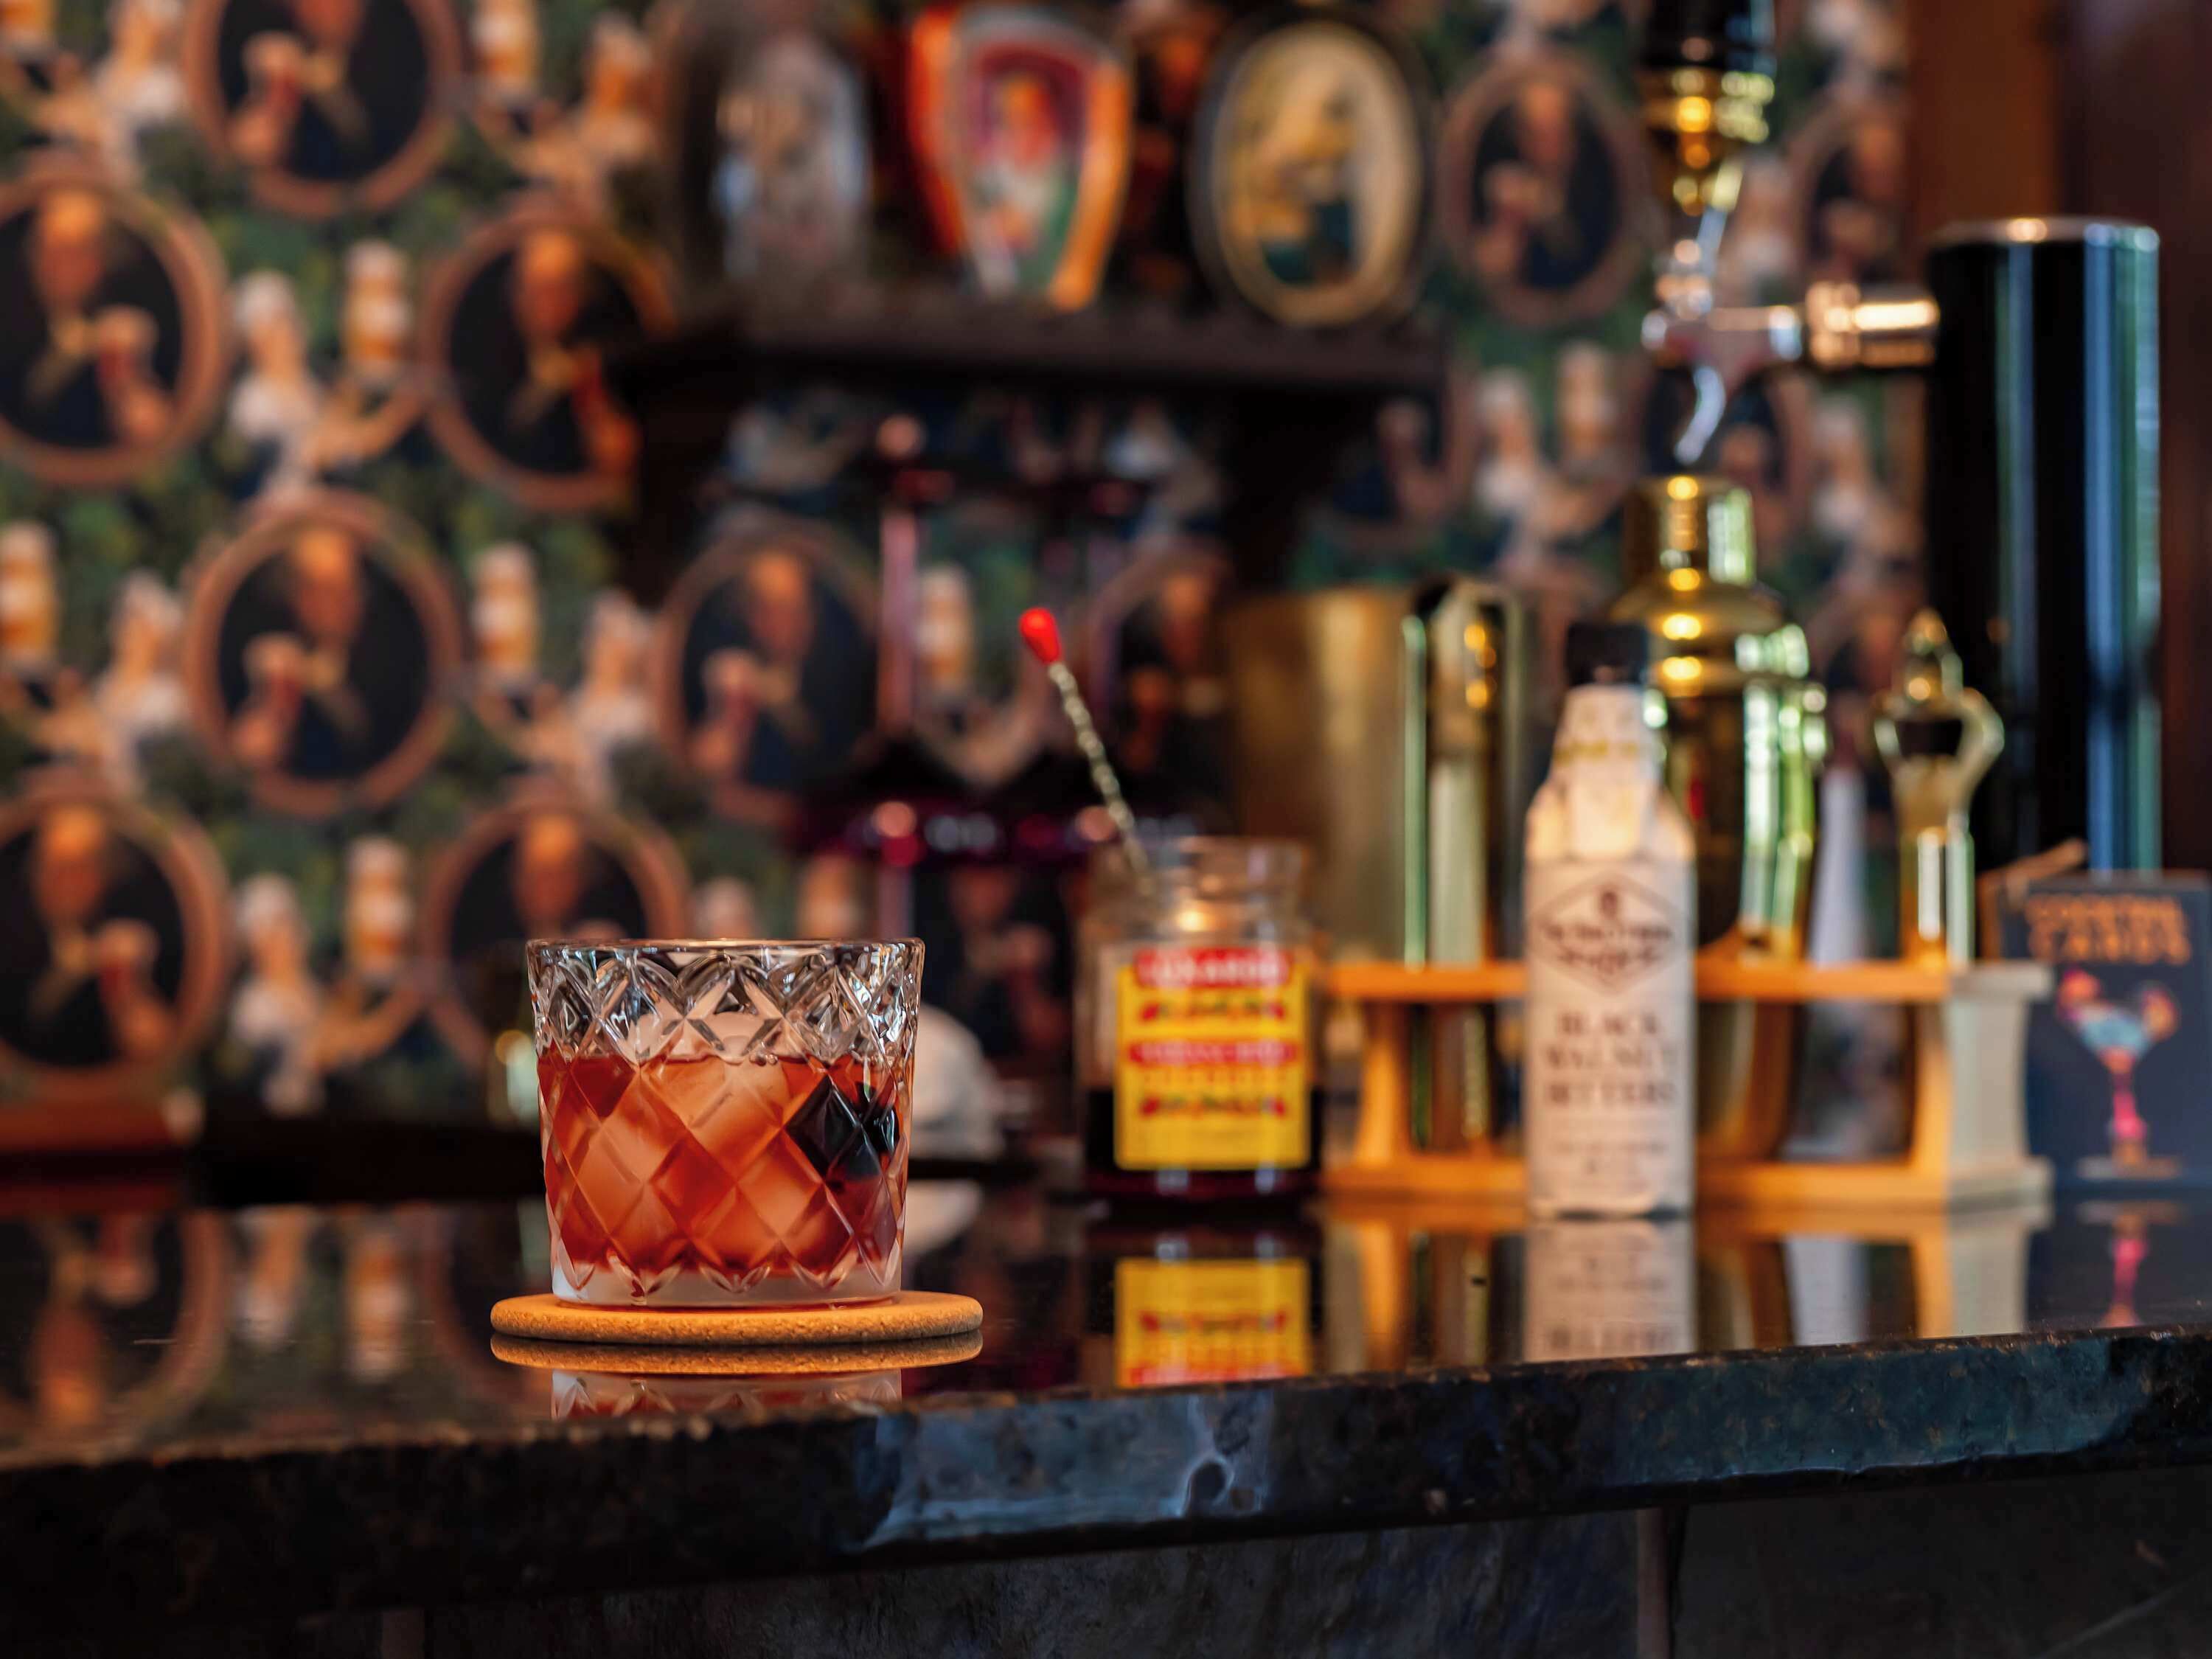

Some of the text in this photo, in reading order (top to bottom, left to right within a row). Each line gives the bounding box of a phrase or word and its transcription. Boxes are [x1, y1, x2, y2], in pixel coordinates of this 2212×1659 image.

[2031, 928, 2190, 963] CARDS
[1559, 1012, 1659, 1034] BLACK
[1547, 1082, 1677, 1105] BITTERS
